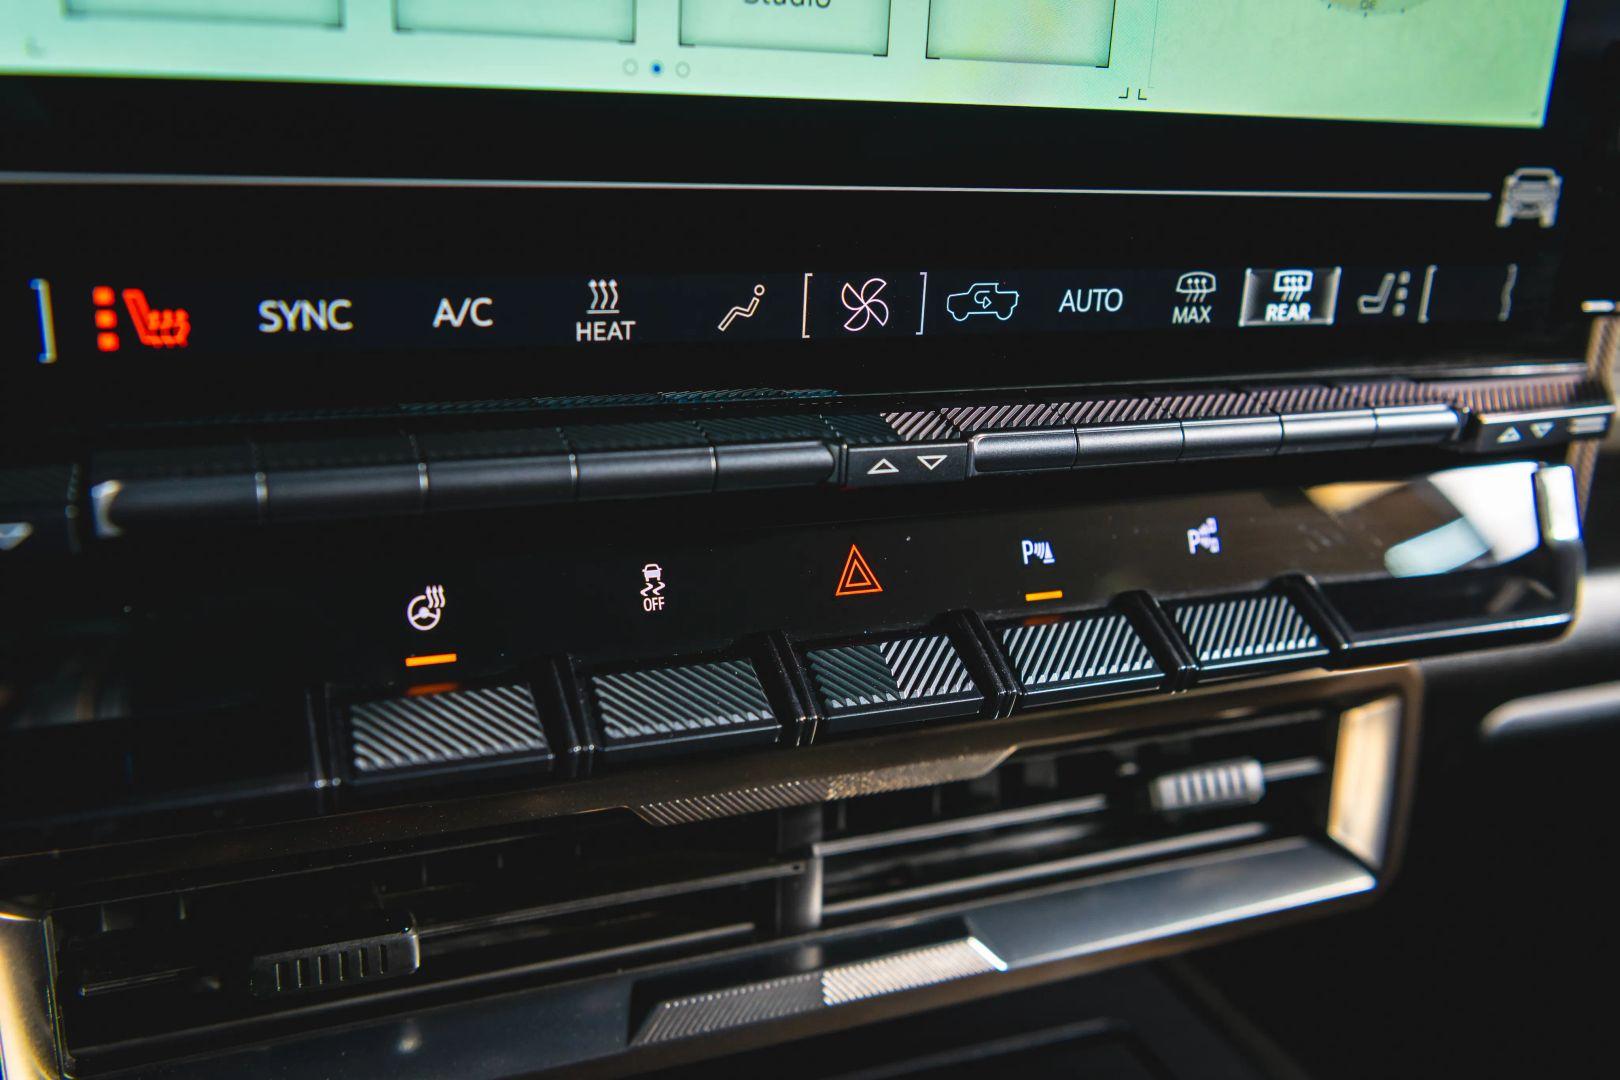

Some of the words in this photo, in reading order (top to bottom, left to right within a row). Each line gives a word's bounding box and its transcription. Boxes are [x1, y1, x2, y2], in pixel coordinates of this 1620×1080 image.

[1058, 288, 1124, 312] AUTO
[258, 299, 353, 332] SYNC
[433, 297, 493, 327] A/C
[1172, 305, 1212, 324] MAX
[1265, 303, 1311, 321] REAR
[576, 321, 636, 341] HEAT
[643, 597, 665, 611] OFF
